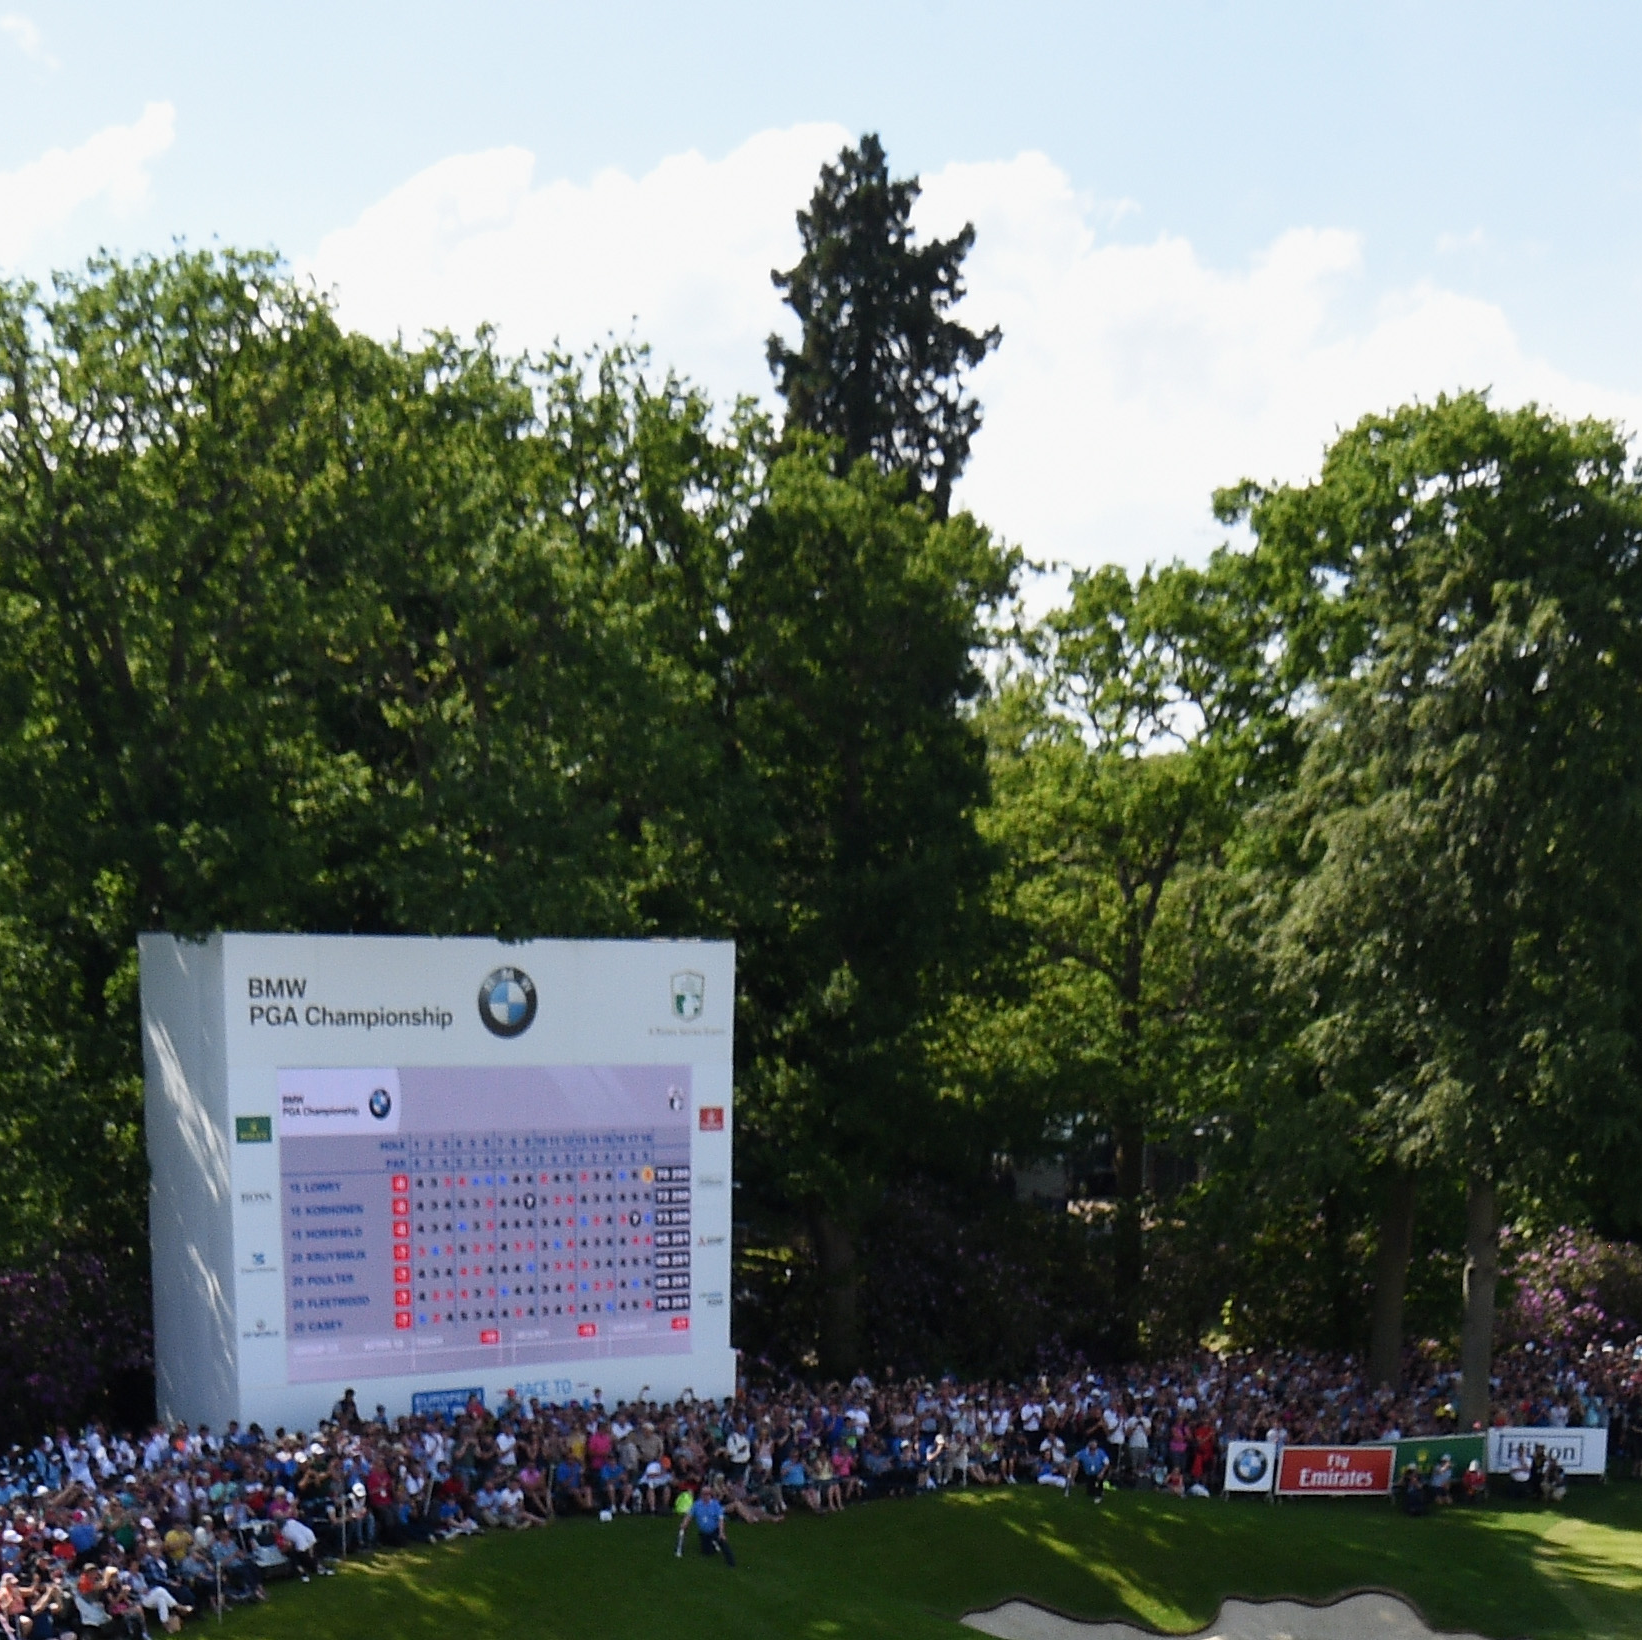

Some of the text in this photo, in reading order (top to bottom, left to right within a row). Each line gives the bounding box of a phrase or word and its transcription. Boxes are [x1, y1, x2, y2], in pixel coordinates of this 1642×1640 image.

[248, 978, 306, 998] BMW
[250, 1004, 453, 1030] PGA Championship
[1327, 1453, 1350, 1470] Fly
[1298, 1467, 1373, 1488] Emirates
